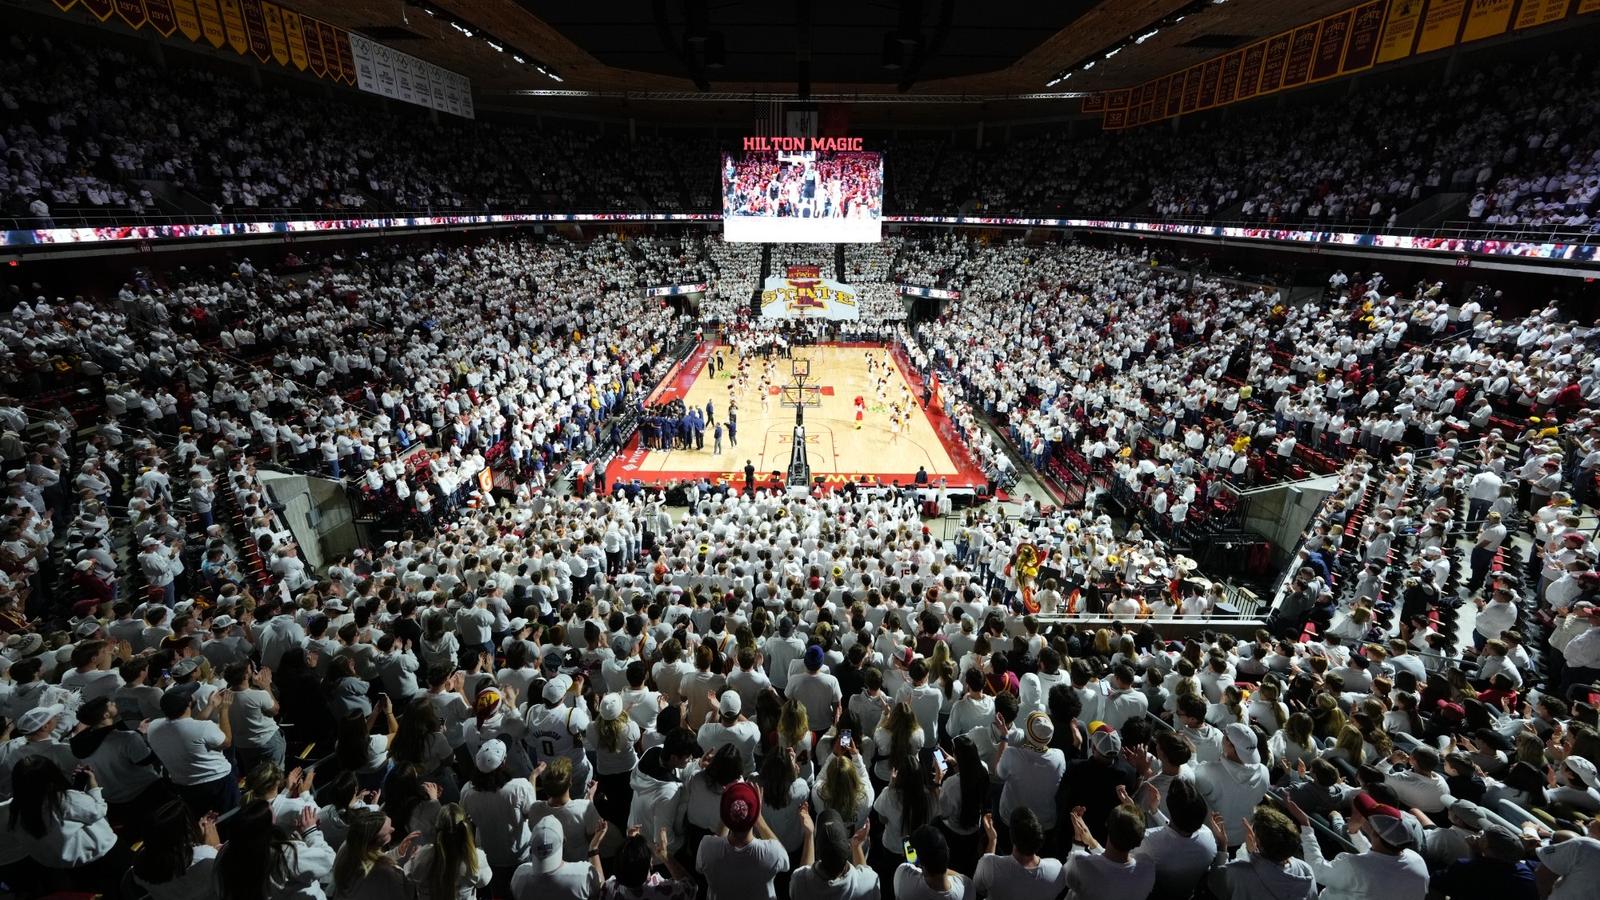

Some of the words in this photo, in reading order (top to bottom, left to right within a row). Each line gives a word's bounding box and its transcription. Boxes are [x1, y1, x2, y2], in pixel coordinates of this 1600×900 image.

[151, 10, 170, 22] 1974
[743, 136, 806, 151] HILTON
[810, 137, 864, 151] MAGIC
[761, 286, 856, 307] STATE
[542, 740, 555, 757] 0
